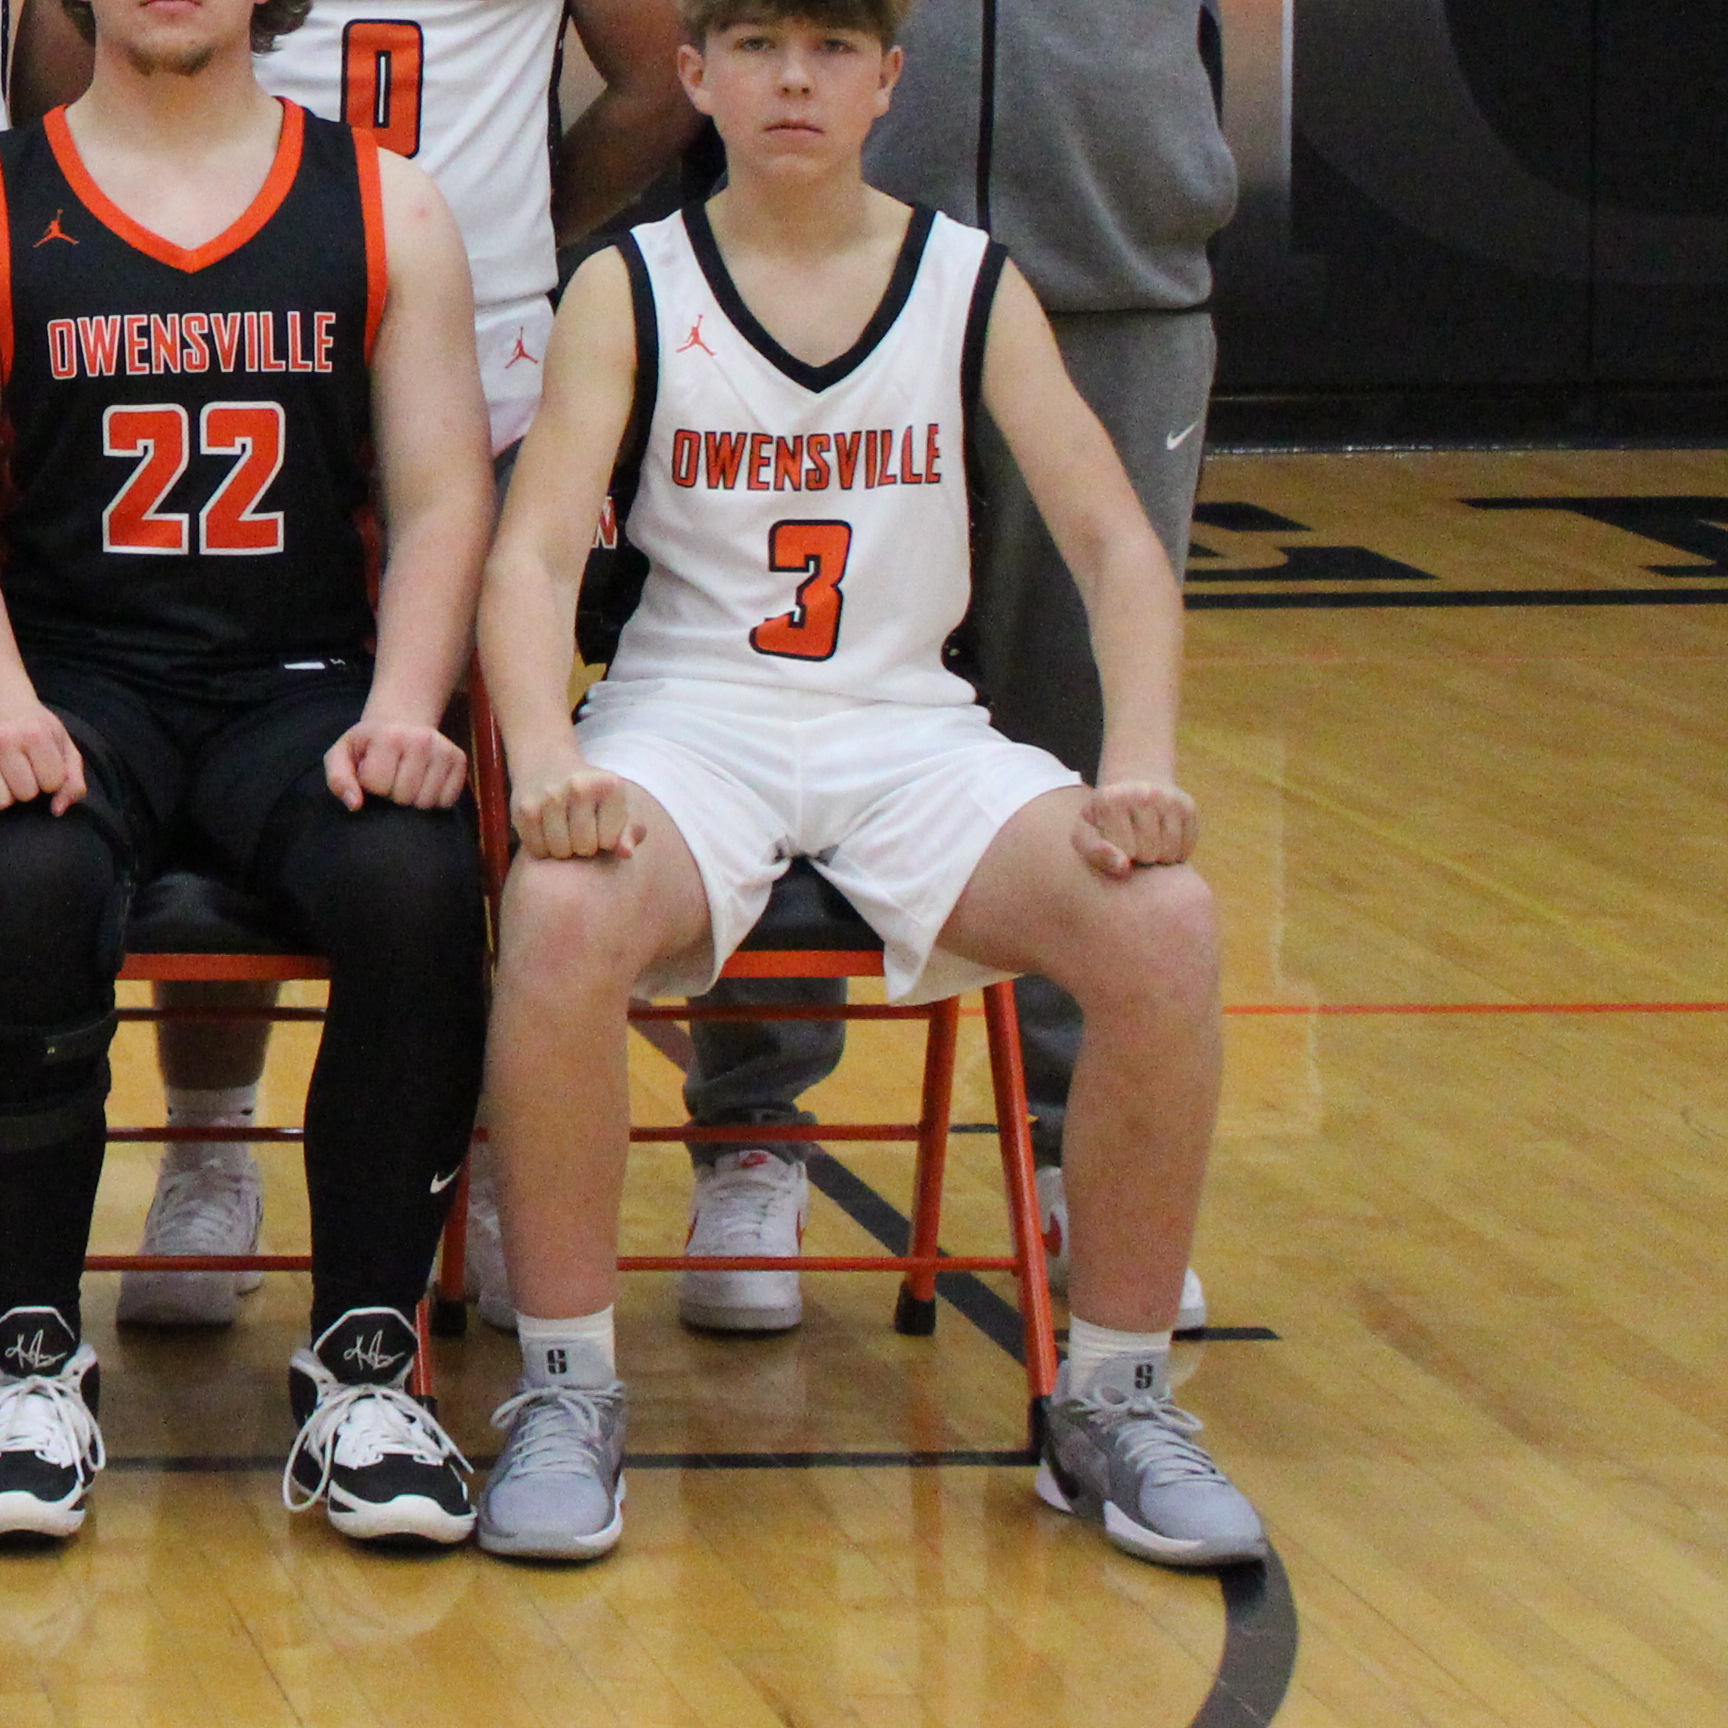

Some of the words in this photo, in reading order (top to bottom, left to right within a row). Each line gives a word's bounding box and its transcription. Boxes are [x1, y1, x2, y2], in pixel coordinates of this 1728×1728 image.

[341, 18, 424, 159] 0
[46, 310, 337, 380] OWENSVILLE
[101, 401, 287, 556] 22
[671, 422, 943, 492] OWENSVILLE
[749, 519, 853, 662] 3
